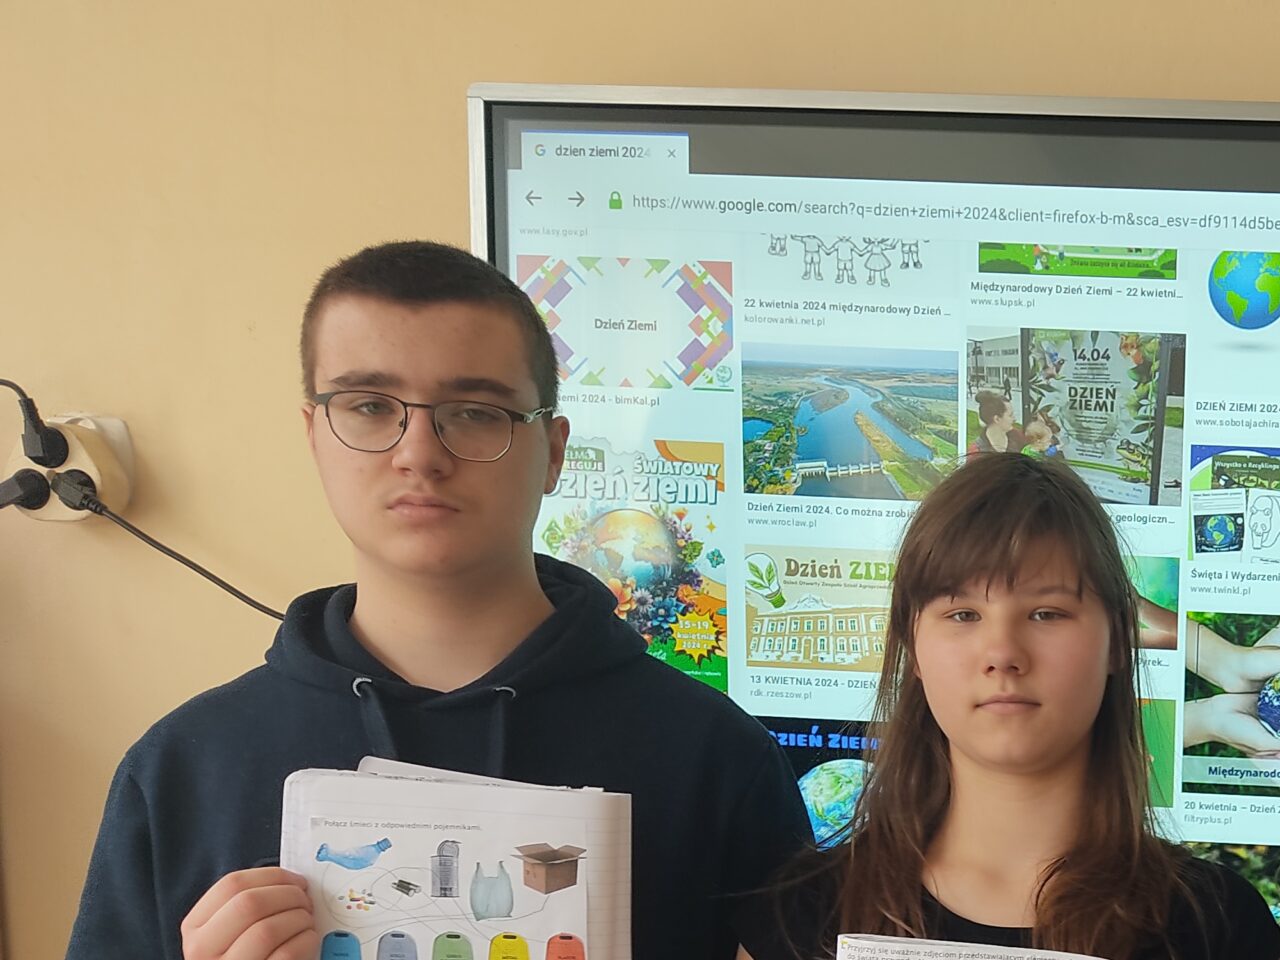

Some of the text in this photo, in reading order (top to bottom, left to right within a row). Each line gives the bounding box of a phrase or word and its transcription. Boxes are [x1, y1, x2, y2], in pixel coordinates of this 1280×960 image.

[554, 143, 586, 157] dzien
[970, 281, 1053, 296] Międzynarodowy
[1055, 284, 1082, 294] Dzień
[1085, 285, 1112, 296] Ziemi
[1126, 287, 1138, 296] 22
[743, 297, 941, 316] 22 kwietnia 2024 międzynarodowy Dzień
[594, 317, 656, 331] Dzień Ziemi
[743, 313, 825, 327] kolorowanki.net.pl
[1072, 346, 1110, 362] 14.04
[556, 392, 578, 407] iemi
[581, 393, 605, 403] 2024
[1067, 383, 1116, 401] DZIEŃ
[1066, 398, 1114, 413] ZIEMI
[1195, 399, 1226, 411] DZIEŃ
[1228, 402, 1256, 412] ZIEMI
[632, 455, 721, 478] ŚWIATOWY
[747, 501, 773, 512] Dzień
[775, 502, 803, 513] Ziemi
[835, 506, 849, 515] Co
[850, 506, 882, 517] można
[784, 556, 842, 582] Dzień
[1190, 567, 1222, 581] Święta
[1225, 570, 1228, 579] i
[749, 674, 878, 693] 13 KWIETNIA 2024 DZIEŃ
[1183, 800, 1196, 810] 20
[1198, 801, 1237, 812] kwietnia
[1249, 803, 1276, 814] Dzień
